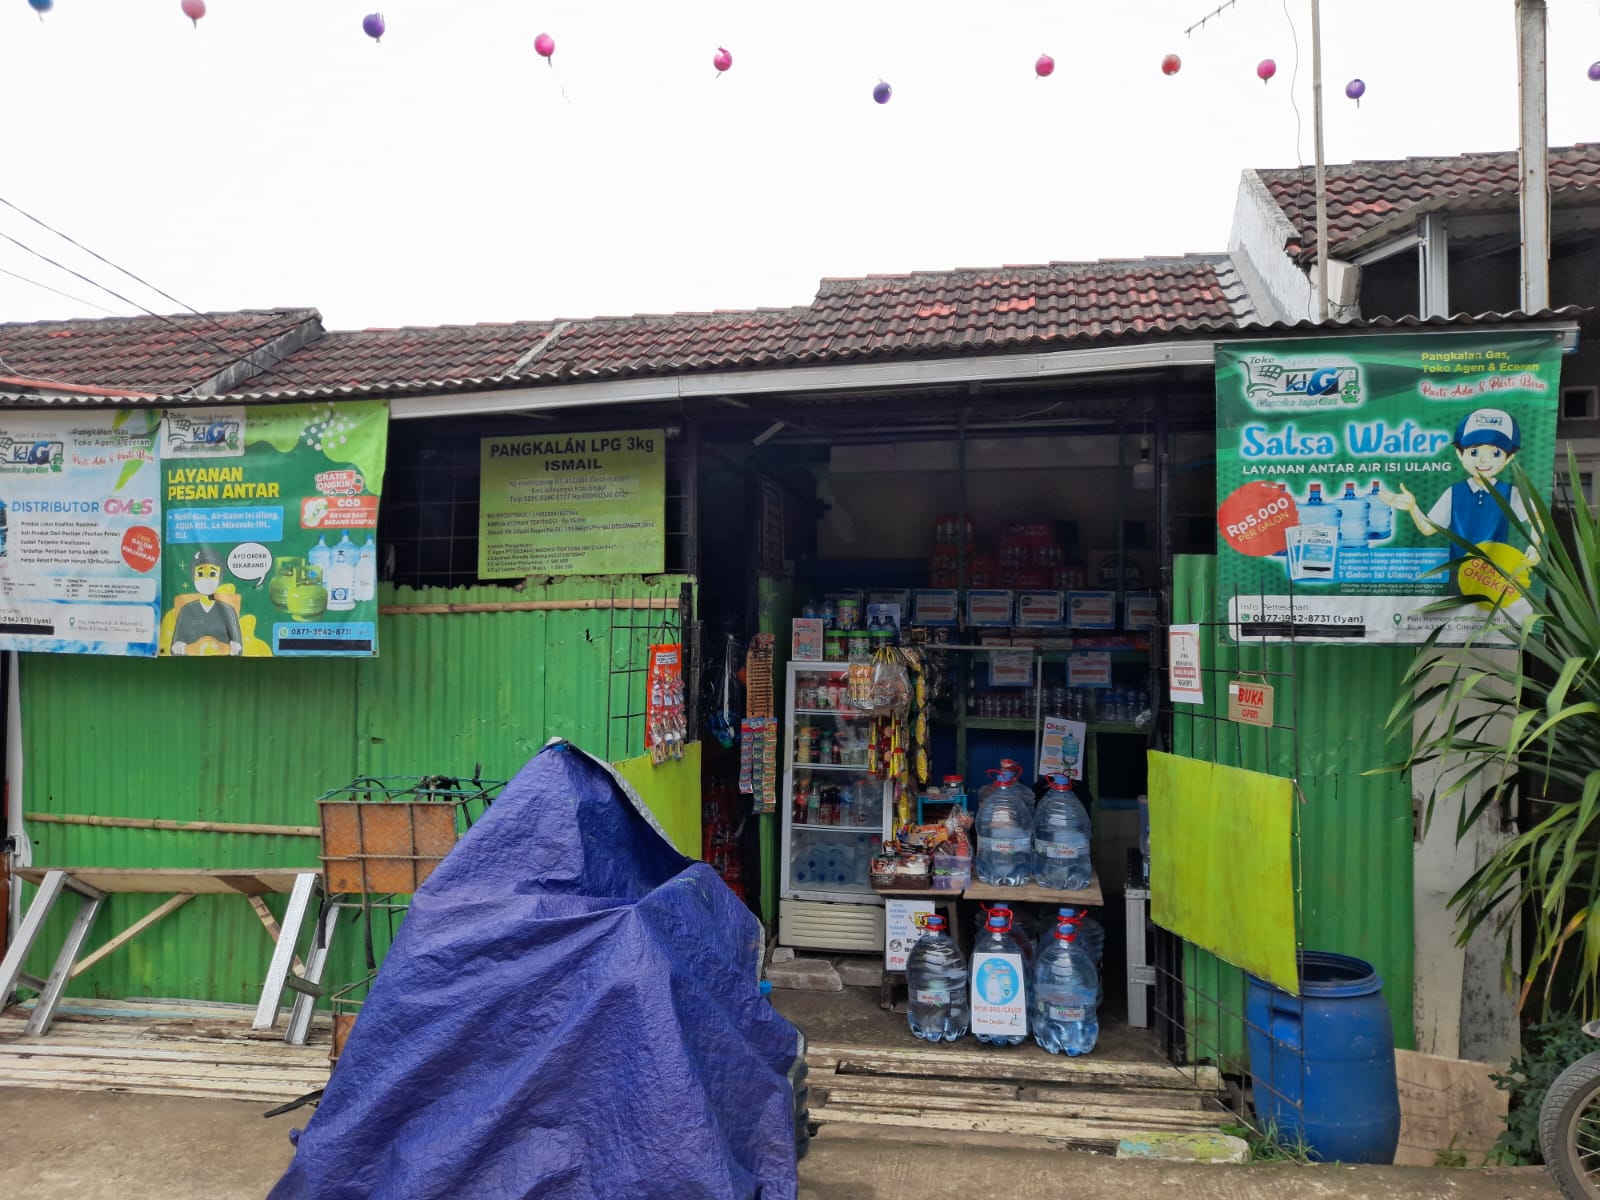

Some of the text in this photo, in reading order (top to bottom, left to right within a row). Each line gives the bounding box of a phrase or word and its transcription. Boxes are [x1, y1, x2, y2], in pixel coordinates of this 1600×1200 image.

[1421, 350, 1510, 362] Pangkalan Gas,
[1423, 362, 1540, 374] Toko Agen & Eceran
[1421, 382, 1448, 397] Pasti
[1451, 384, 1474, 397] Ada
[72, 428, 129, 437] Pangkalan Gas
[1243, 421, 1450, 457] Salsa Water
[95, 439, 114, 447] Agen
[592, 438, 621, 453] LPG
[627, 436, 654, 453] 3kg
[545, 458, 603, 471] ISMAIL
[1243, 461, 1451, 475] LAYANAN ANTAR AIR ISI ULANG
[168, 466, 243, 484] LAYANAN
[316, 472, 347, 483] GRATIS
[168, 482, 280, 501] PESAN ANTAR
[317, 480, 351, 490] ONGKIR
[12, 498, 153, 515] DISTRIBUTOR GMeS
[337, 499, 361, 508] COD
[1226, 497, 1289, 538] Rp5.000
[1238, 511, 1290, 543] PER GALON
[1345, 571, 1372, 579] Galon
[1374, 571, 1385, 579] Isi
[1387, 571, 1413, 581] Ulang
[1463, 567, 1516, 597] ONGKIR
[1241, 603, 1259, 611] Info
[1238, 688, 1264, 705] BUKA
[1241, 708, 1259, 719] OPEN
